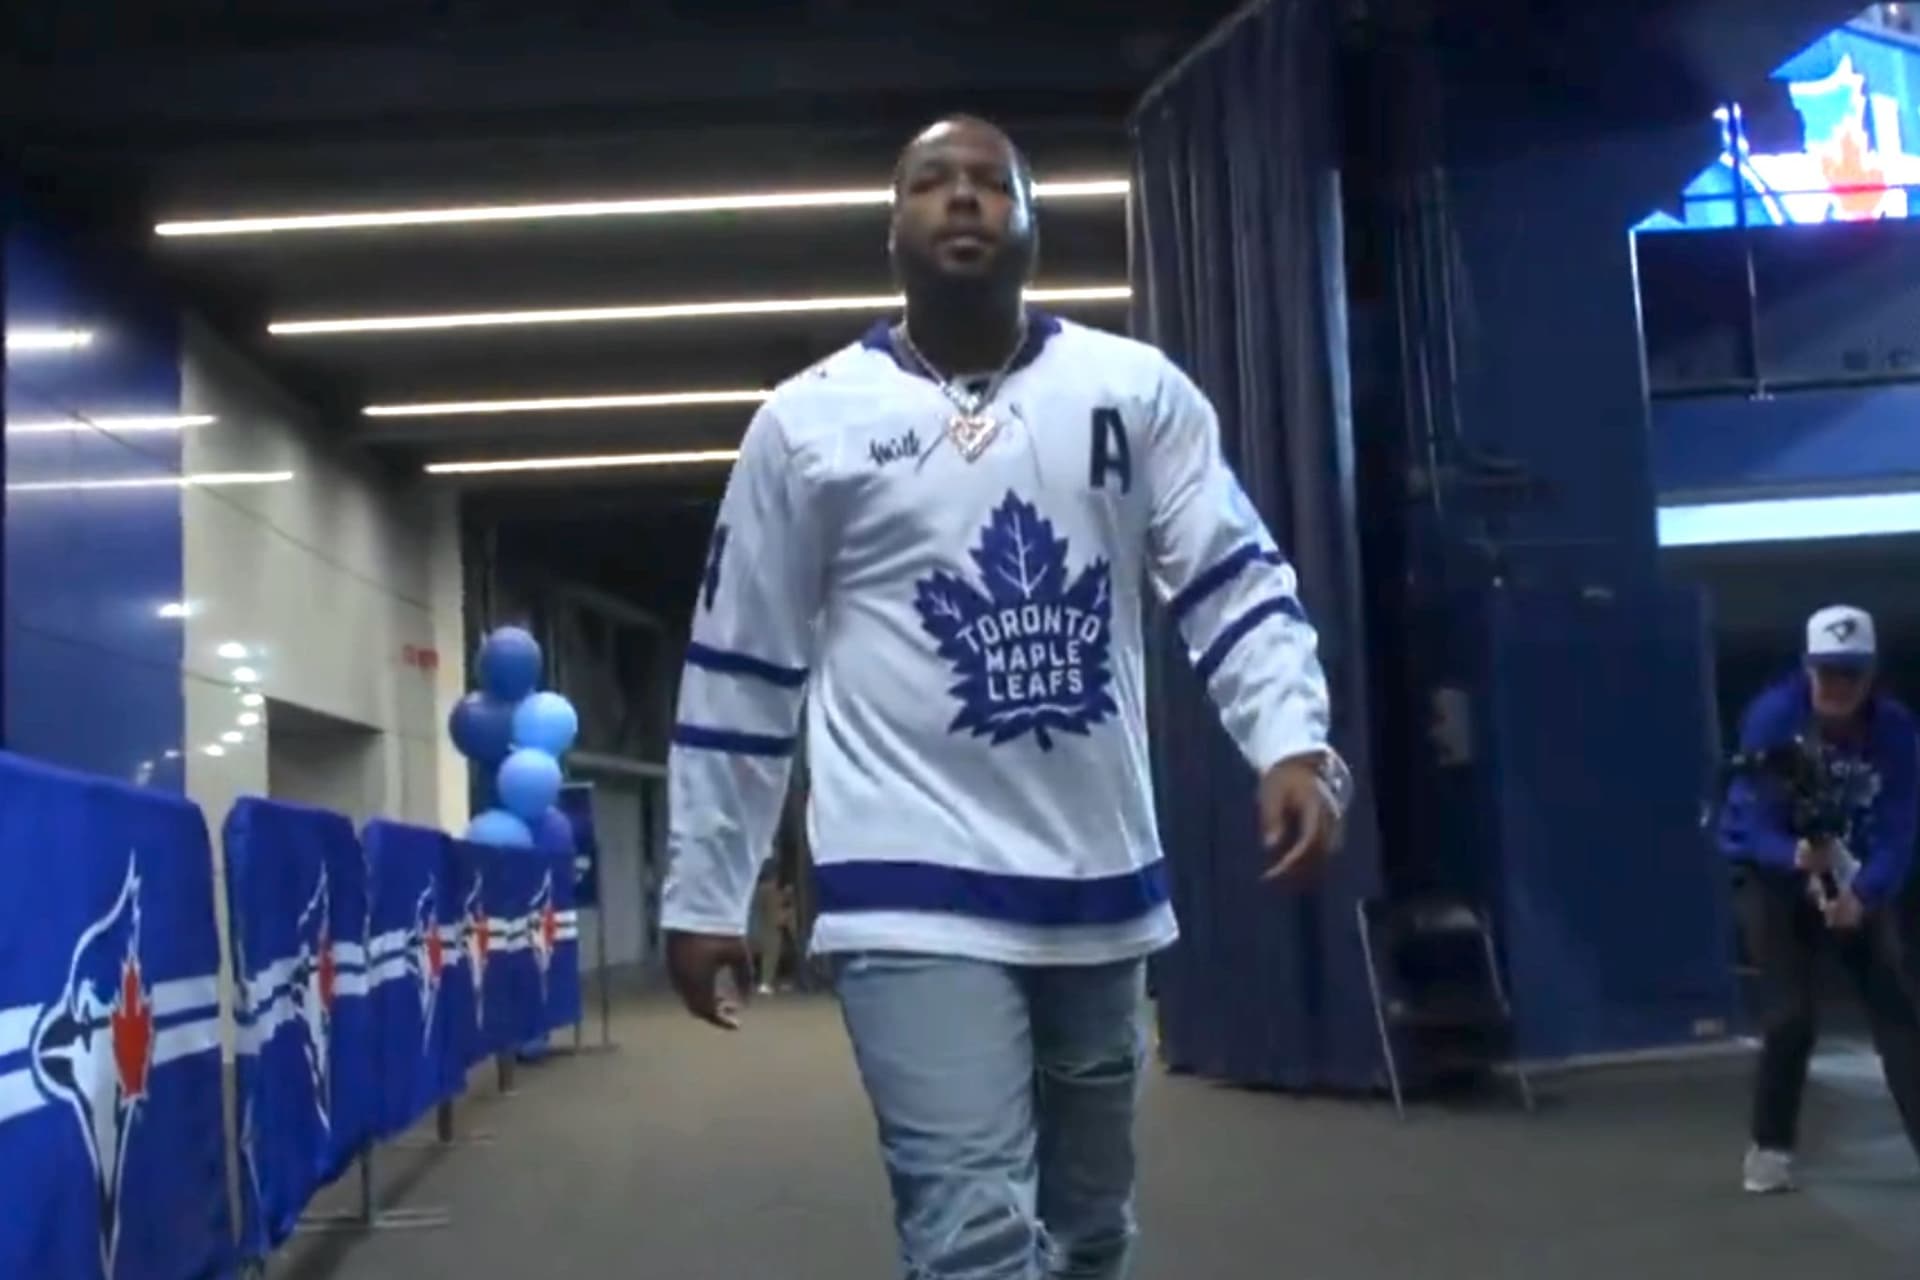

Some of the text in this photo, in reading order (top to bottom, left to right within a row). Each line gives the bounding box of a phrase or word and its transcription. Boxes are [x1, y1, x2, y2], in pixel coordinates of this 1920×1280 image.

[1090, 407, 1131, 495] A
[956, 604, 1100, 653] TORONTO
[985, 640, 1081, 672] MAPLE
[988, 668, 1083, 701] LEAFS
